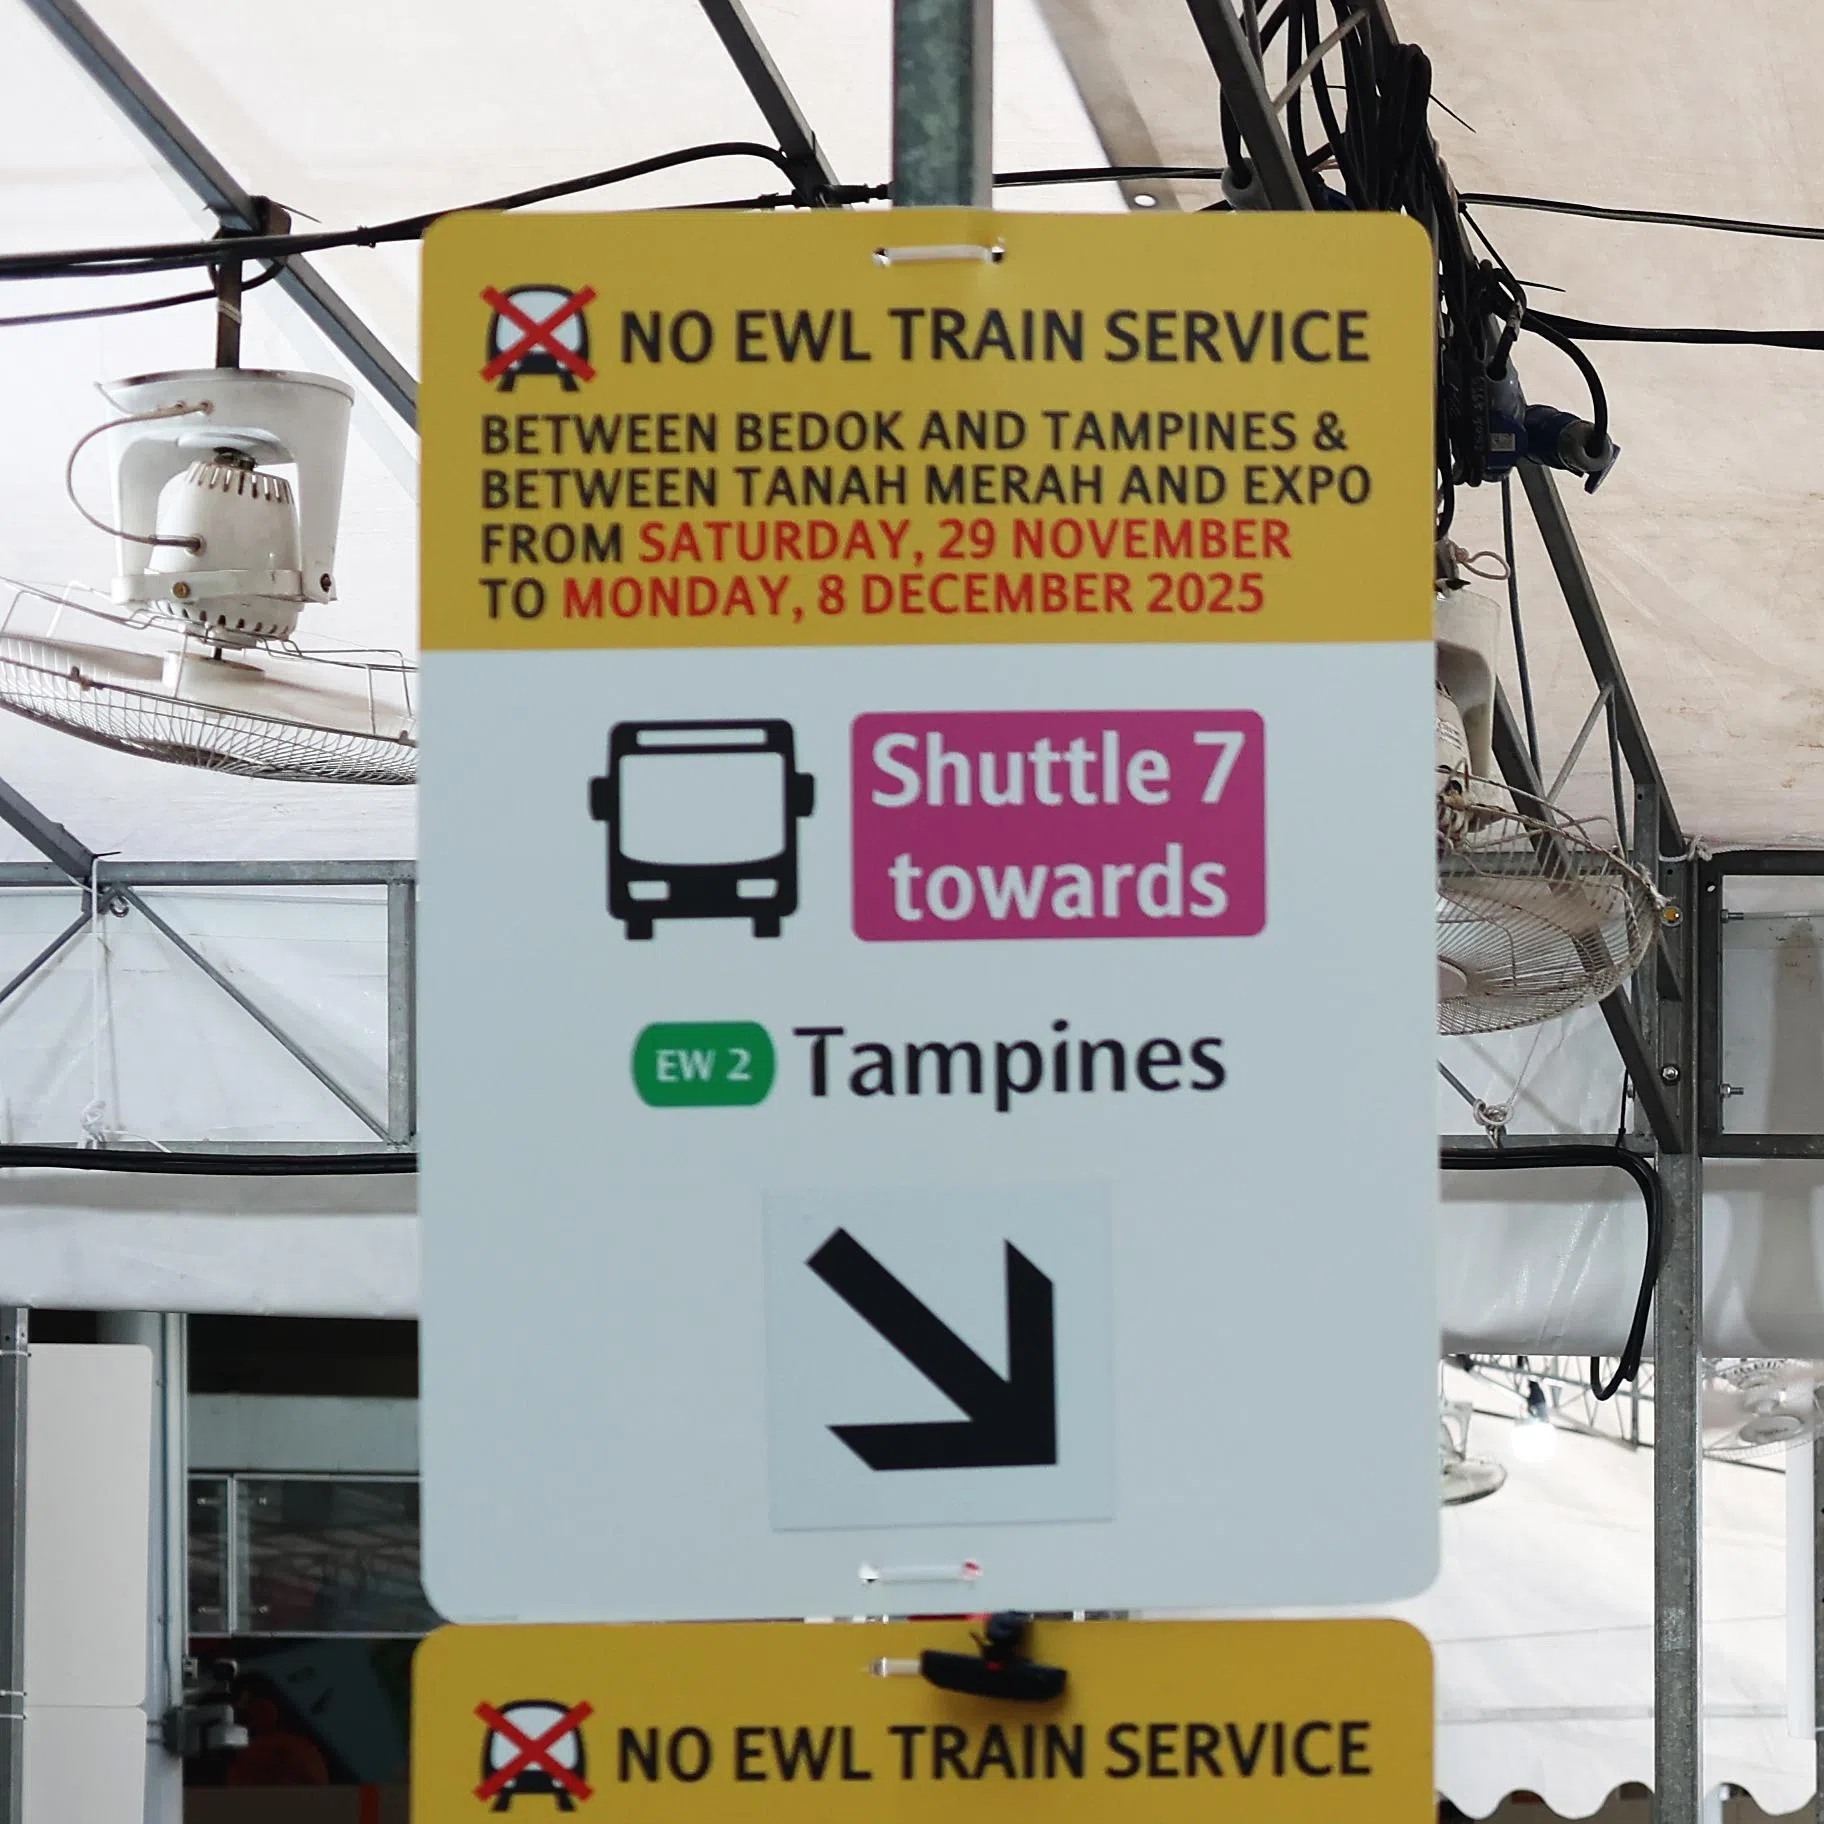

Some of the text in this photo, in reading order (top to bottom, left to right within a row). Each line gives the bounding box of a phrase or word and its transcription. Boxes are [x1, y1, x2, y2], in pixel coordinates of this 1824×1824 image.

[621, 307, 1370, 365] NO EWL TRAIN SERVICE
[481, 409, 1349, 456] BETWEEN BEDOK AND TAMPINES &
[481, 463, 1371, 511] BETWEEN TANAH MERAH AND EXPO
[481, 517, 1292, 567] FROM SATURDAY, 29 NOVEMBER
[478, 571, 1265, 624] TO MONDAY, 8 DECEMBER 2025
[871, 729, 1246, 808] Shuttle 7
[887, 842, 1229, 922] towards
[655, 1018, 1226, 1113] EW 2 Tampines
